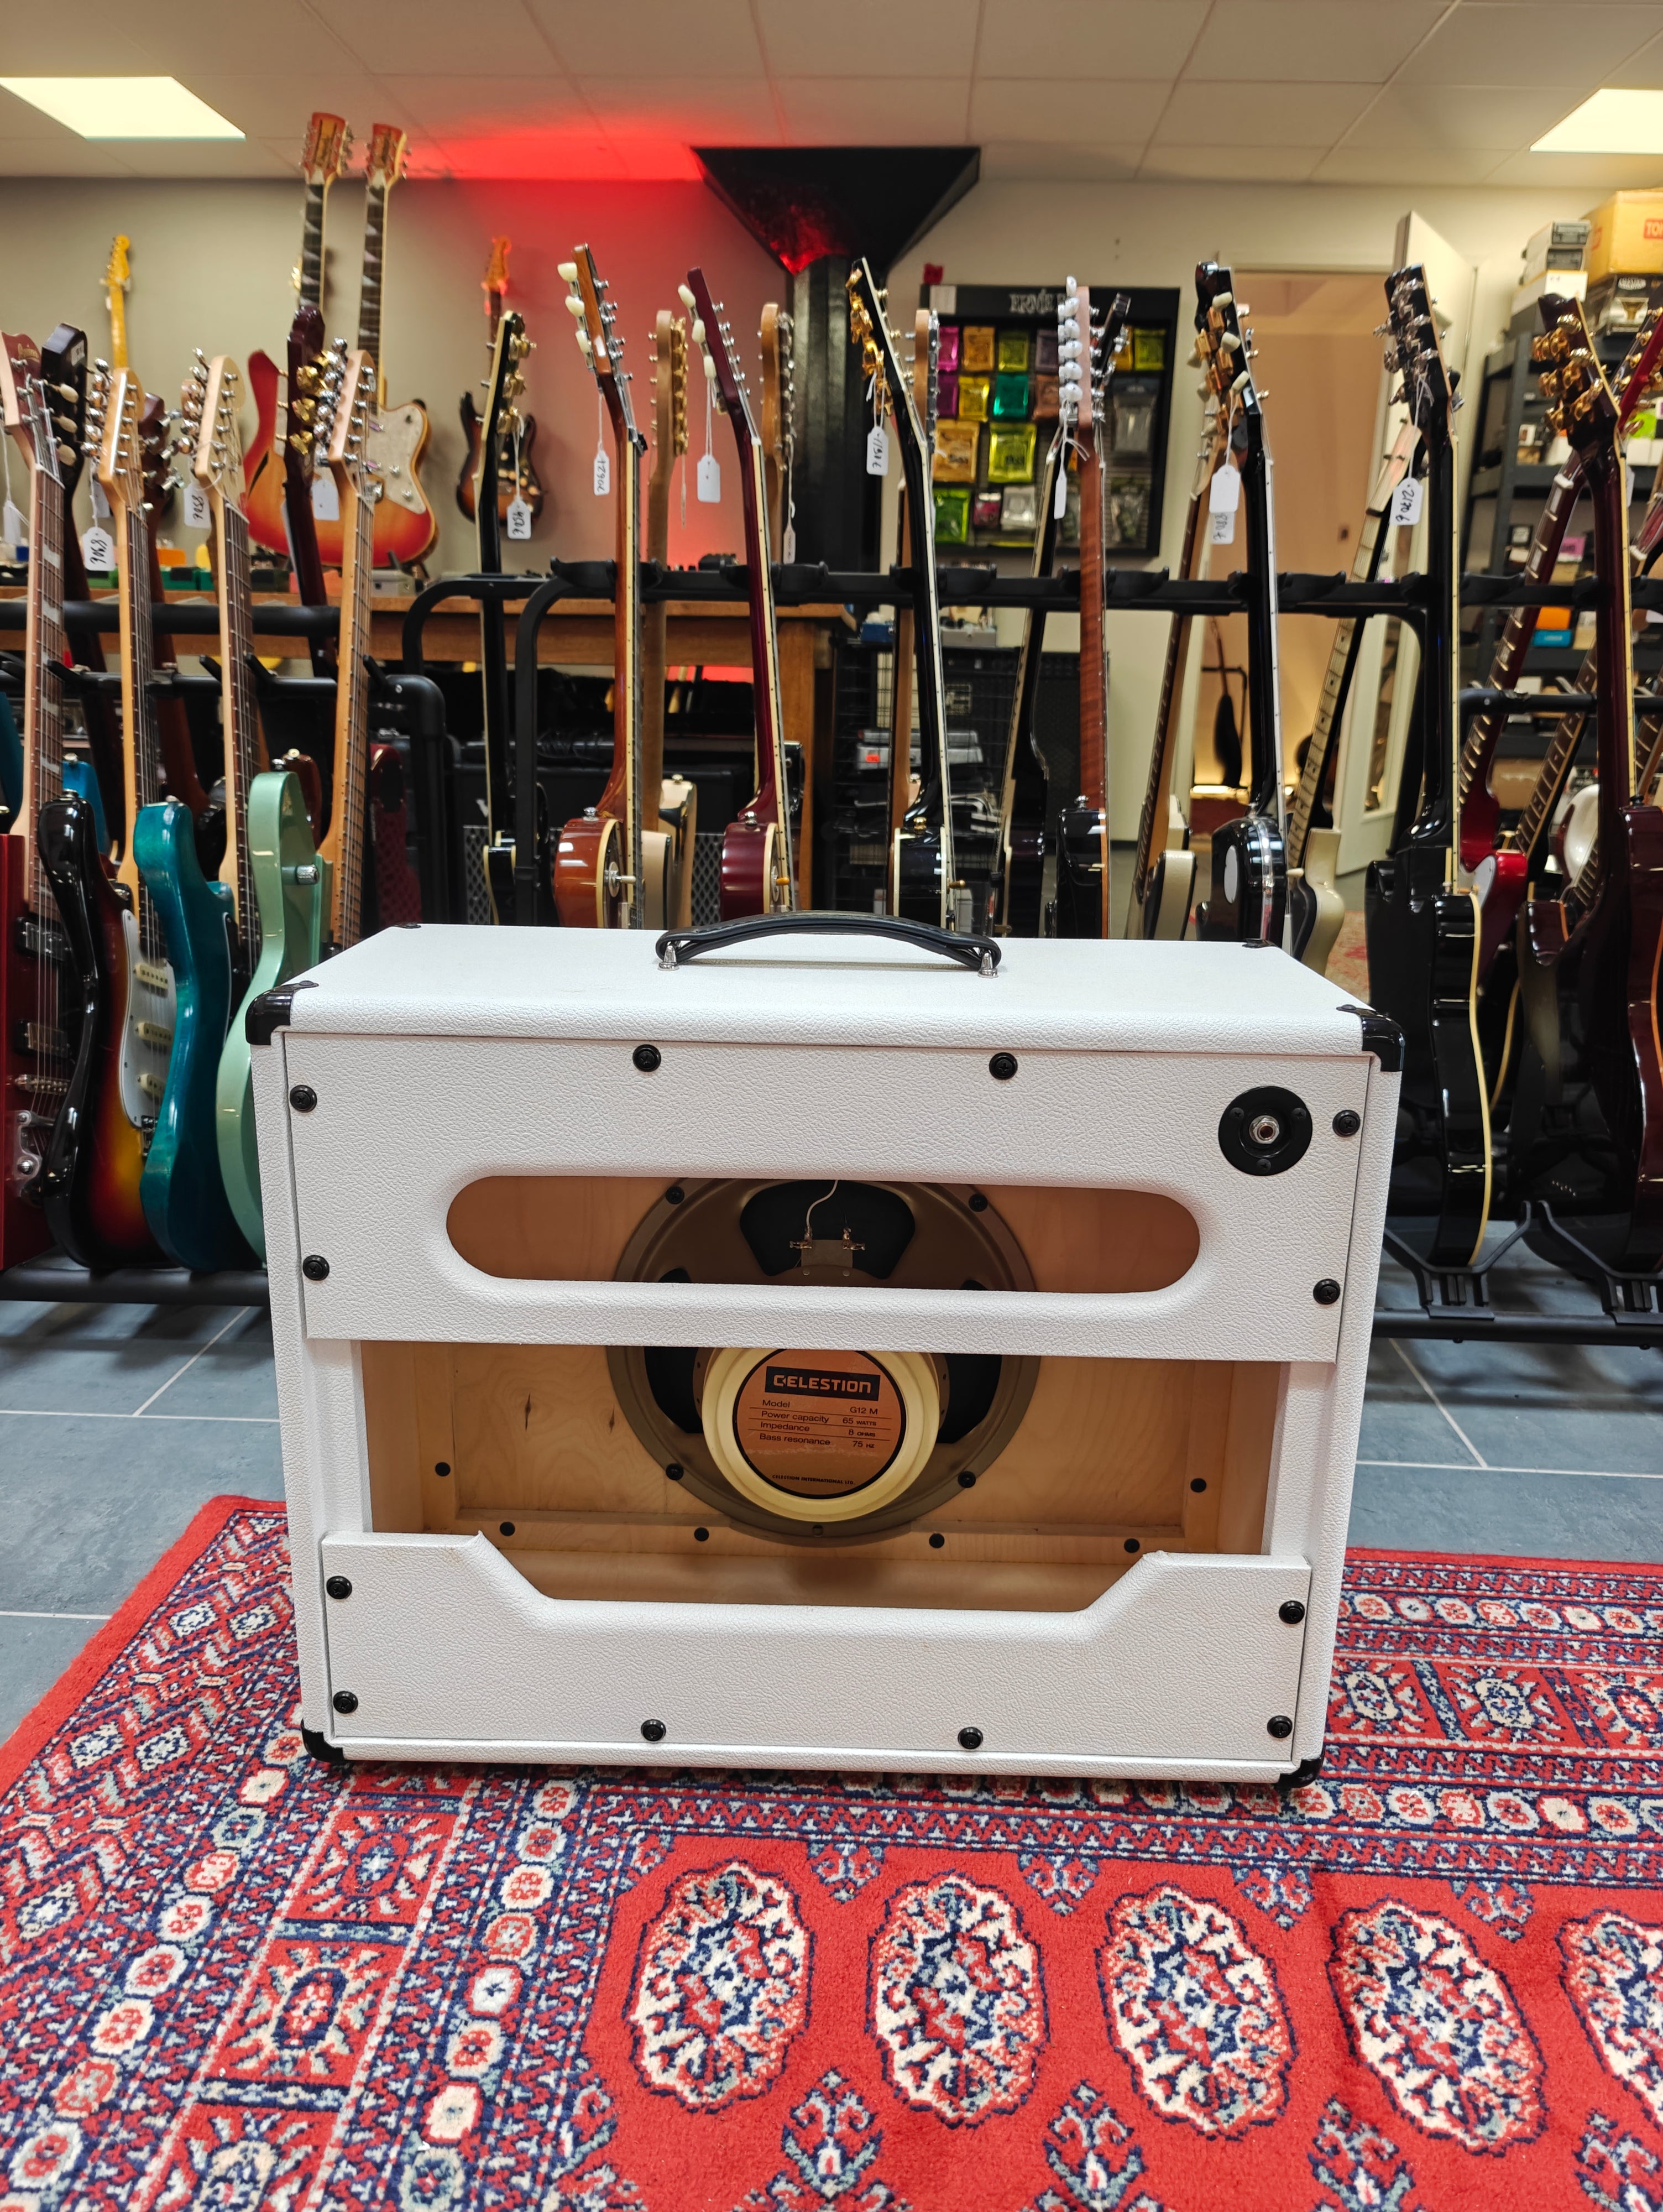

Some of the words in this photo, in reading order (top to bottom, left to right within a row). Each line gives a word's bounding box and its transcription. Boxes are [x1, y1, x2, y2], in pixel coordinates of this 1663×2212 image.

[1646, 221, 1663, 237] TO
[773, 1374, 871, 1394] CELESTION
[762, 1399, 790, 1408] Model
[761, 1410, 790, 1419] Power
[792, 1415, 829, 1424] capacity
[760, 1421, 810, 1432] Impedance
[759, 1433, 782, 1441] Bass
[784, 1436, 830, 1446] resonance
[801, 1476, 844, 1484] INTERNATIONAL
